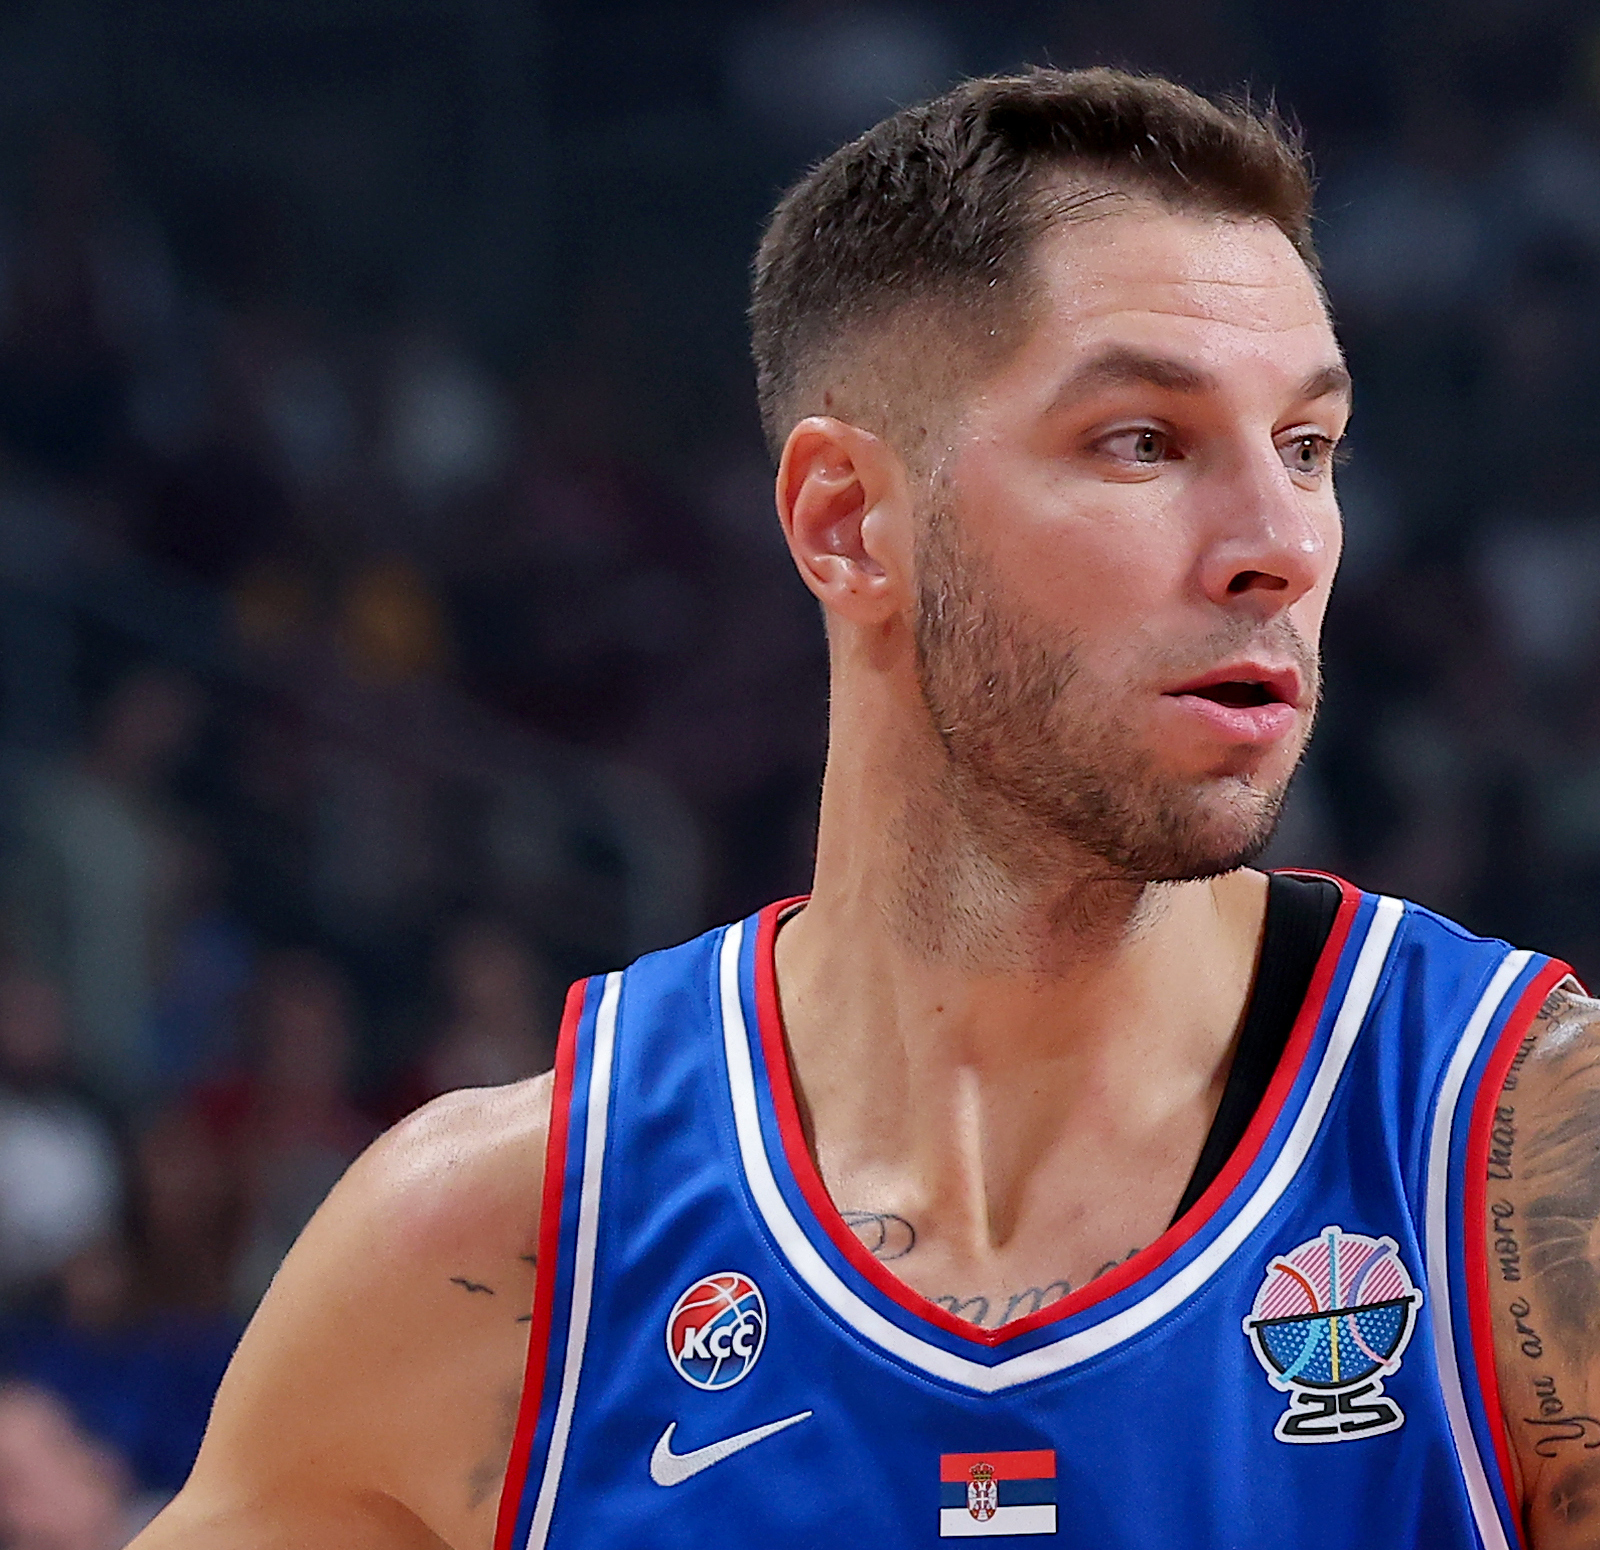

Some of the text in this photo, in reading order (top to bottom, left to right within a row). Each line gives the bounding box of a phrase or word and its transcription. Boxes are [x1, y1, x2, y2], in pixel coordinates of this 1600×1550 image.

[1491, 1200, 1521, 1282] more
[683, 1324, 755, 1360] KCC
[1510, 1297, 1544, 1358] are
